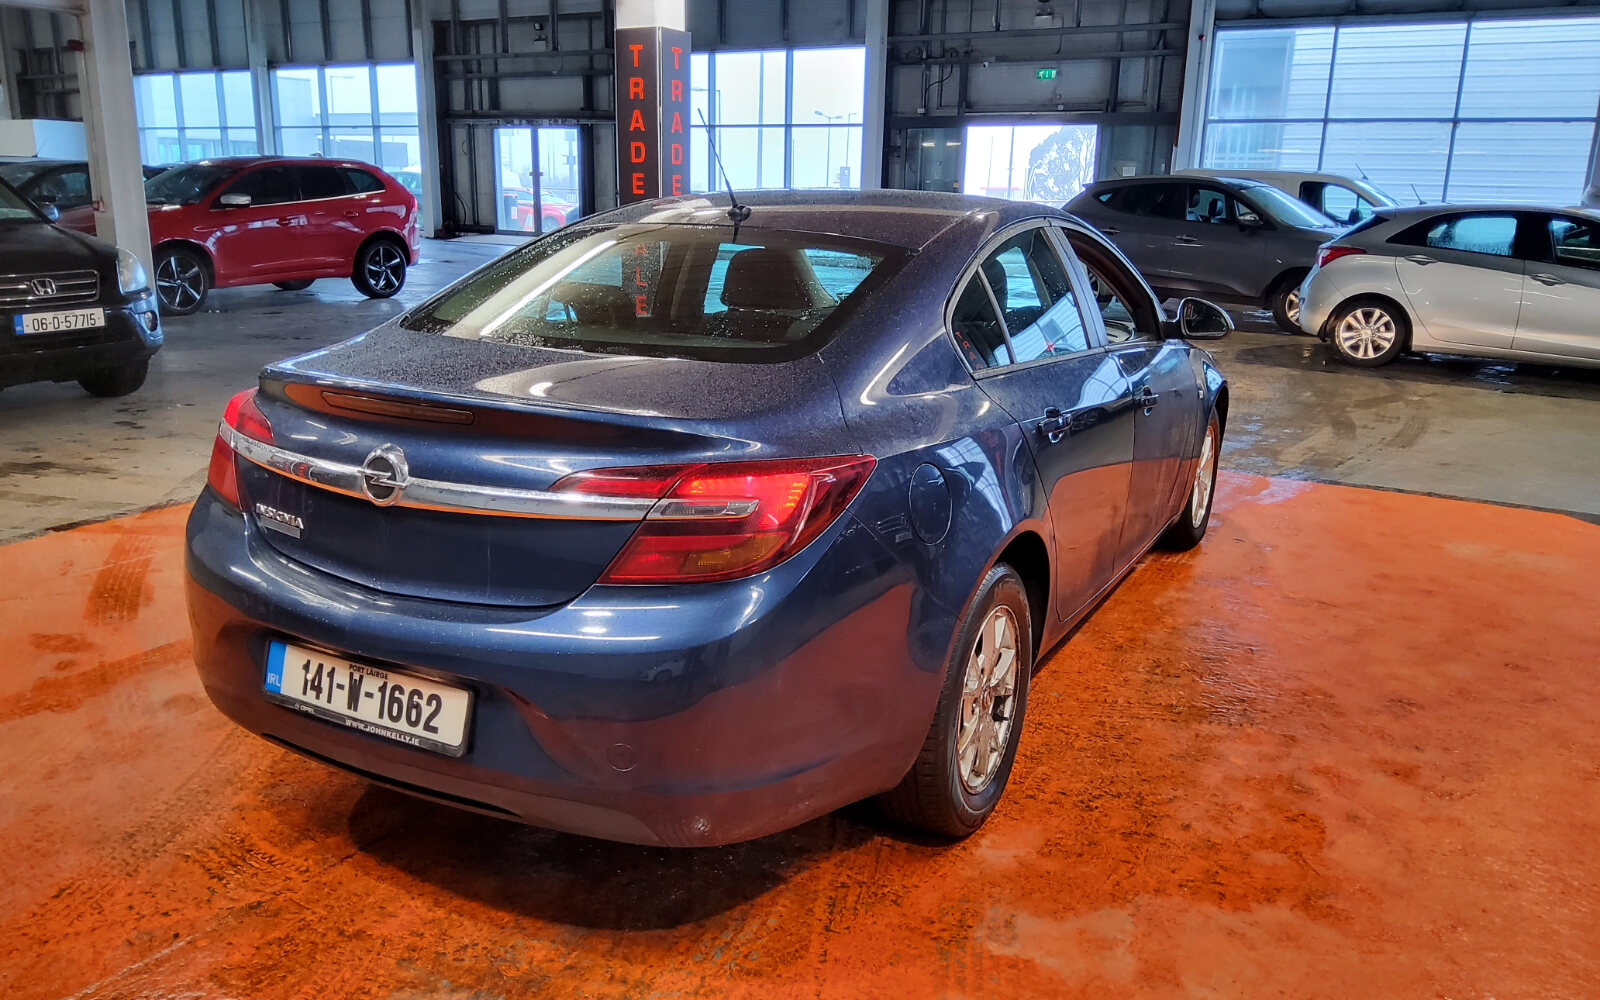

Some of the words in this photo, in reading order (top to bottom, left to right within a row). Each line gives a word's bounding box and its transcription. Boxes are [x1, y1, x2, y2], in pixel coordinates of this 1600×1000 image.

[629, 44, 646, 195] TRADE
[671, 46, 683, 196] TRADE
[633, 243, 648, 315] ALE
[32, 313, 96, 331] 06-D-57715
[267, 672, 281, 687] IRL
[302, 659, 443, 735] 141-W-1662
[349, 663, 365, 674] PORT
[345, 718, 420, 746] WWW.JOHNKELLY.IE
